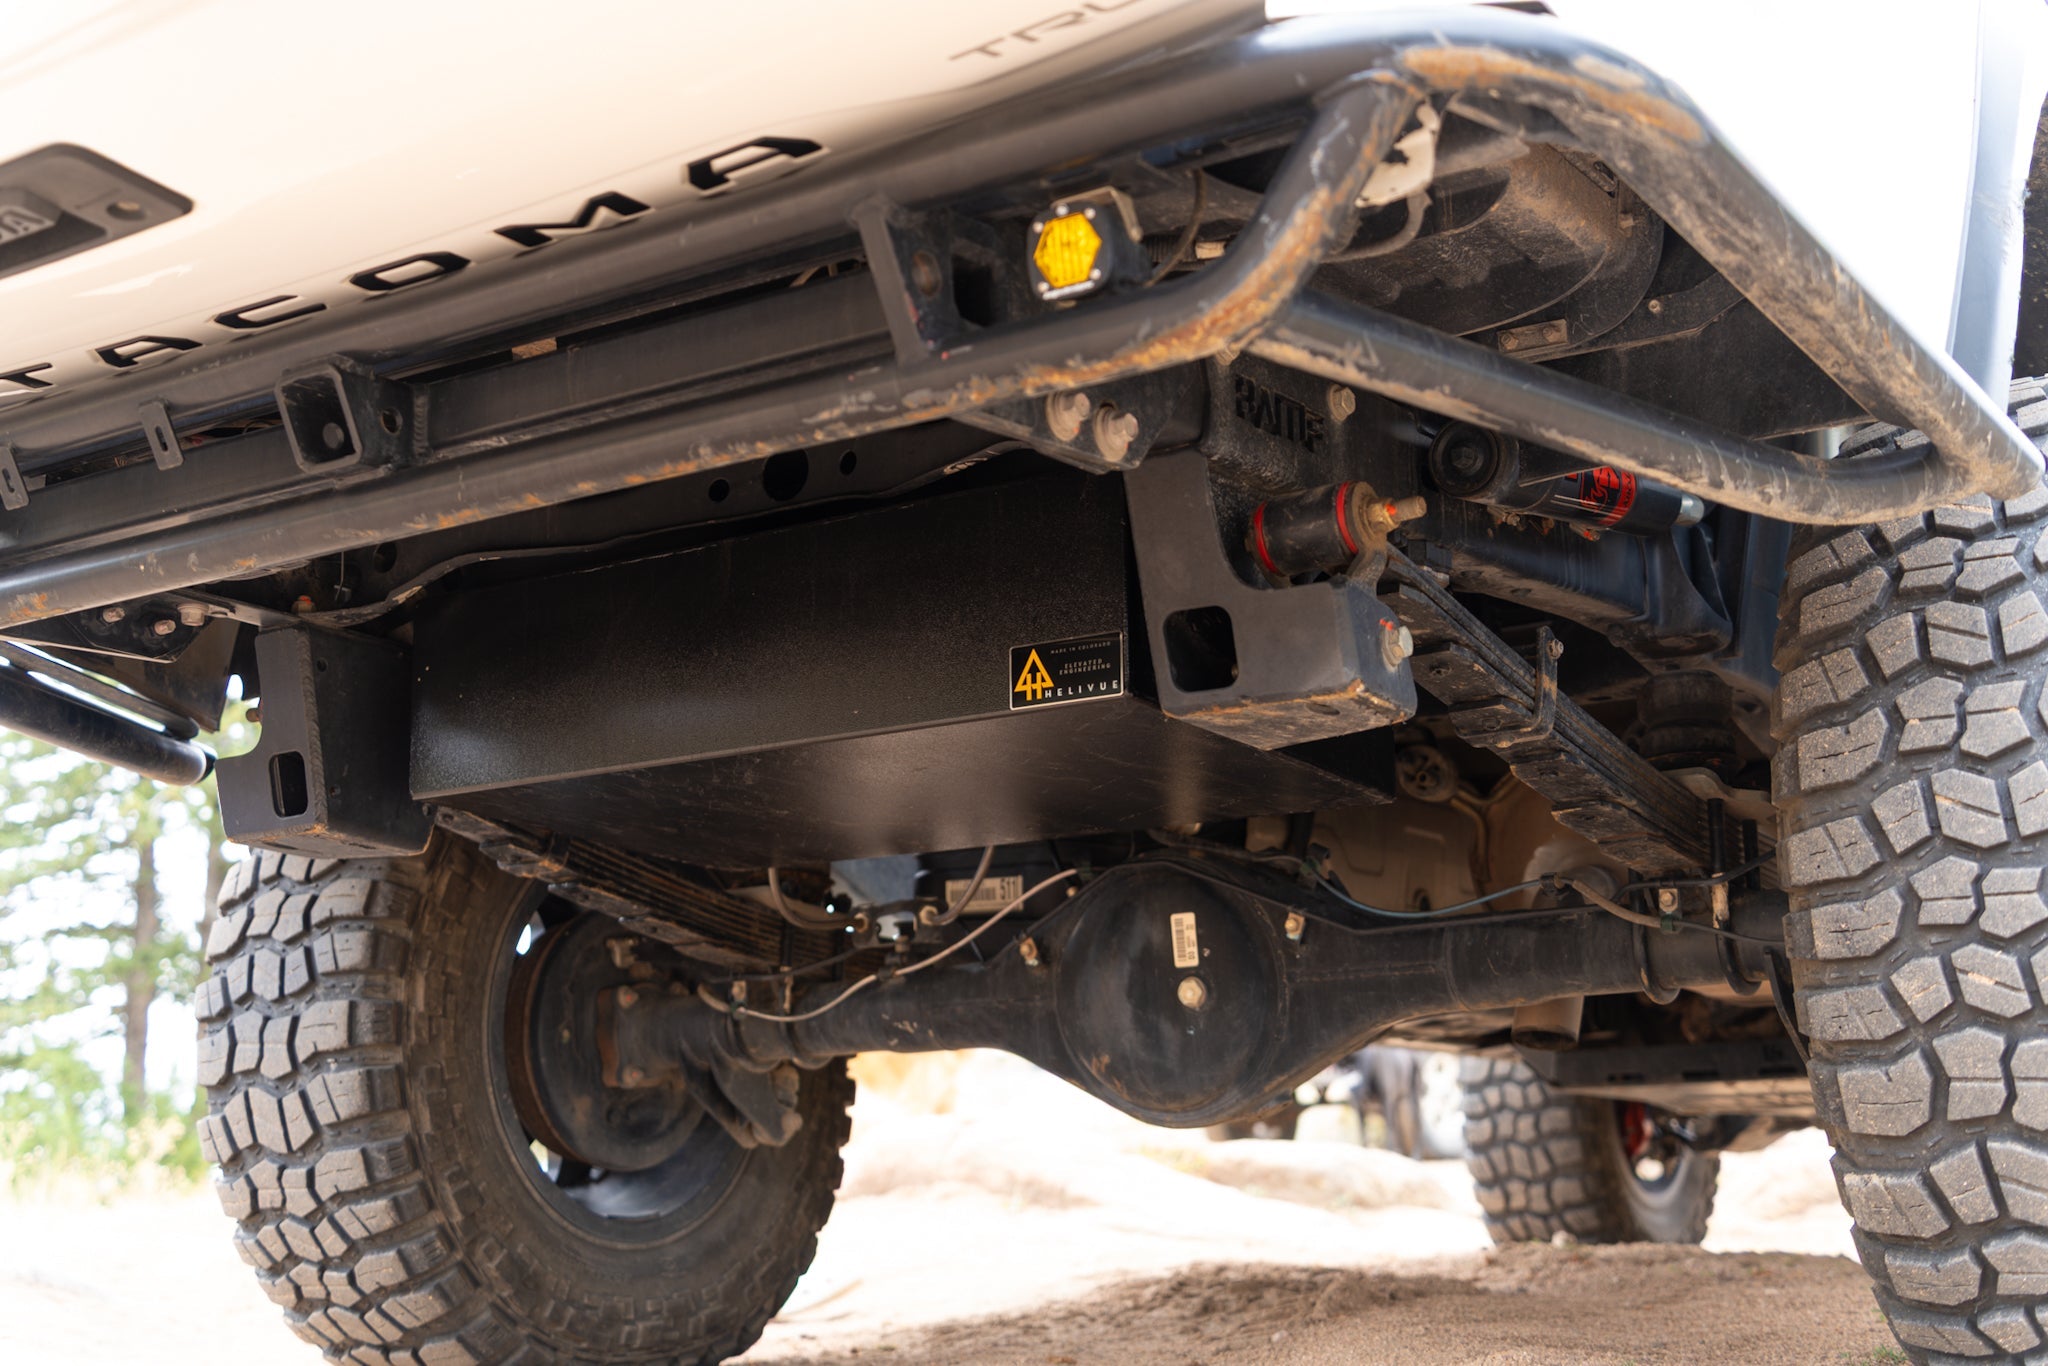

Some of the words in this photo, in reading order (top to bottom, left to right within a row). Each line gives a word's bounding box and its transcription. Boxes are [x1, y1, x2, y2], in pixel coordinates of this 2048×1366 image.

[0, 136, 823, 389] TACOMA
[1078, 641, 1111, 651] COLORADO
[1059, 663, 1111, 675] ENGINEERING
[1064, 658, 1103, 669] ELEVATED
[1045, 680, 1118, 698] HELIVUE
